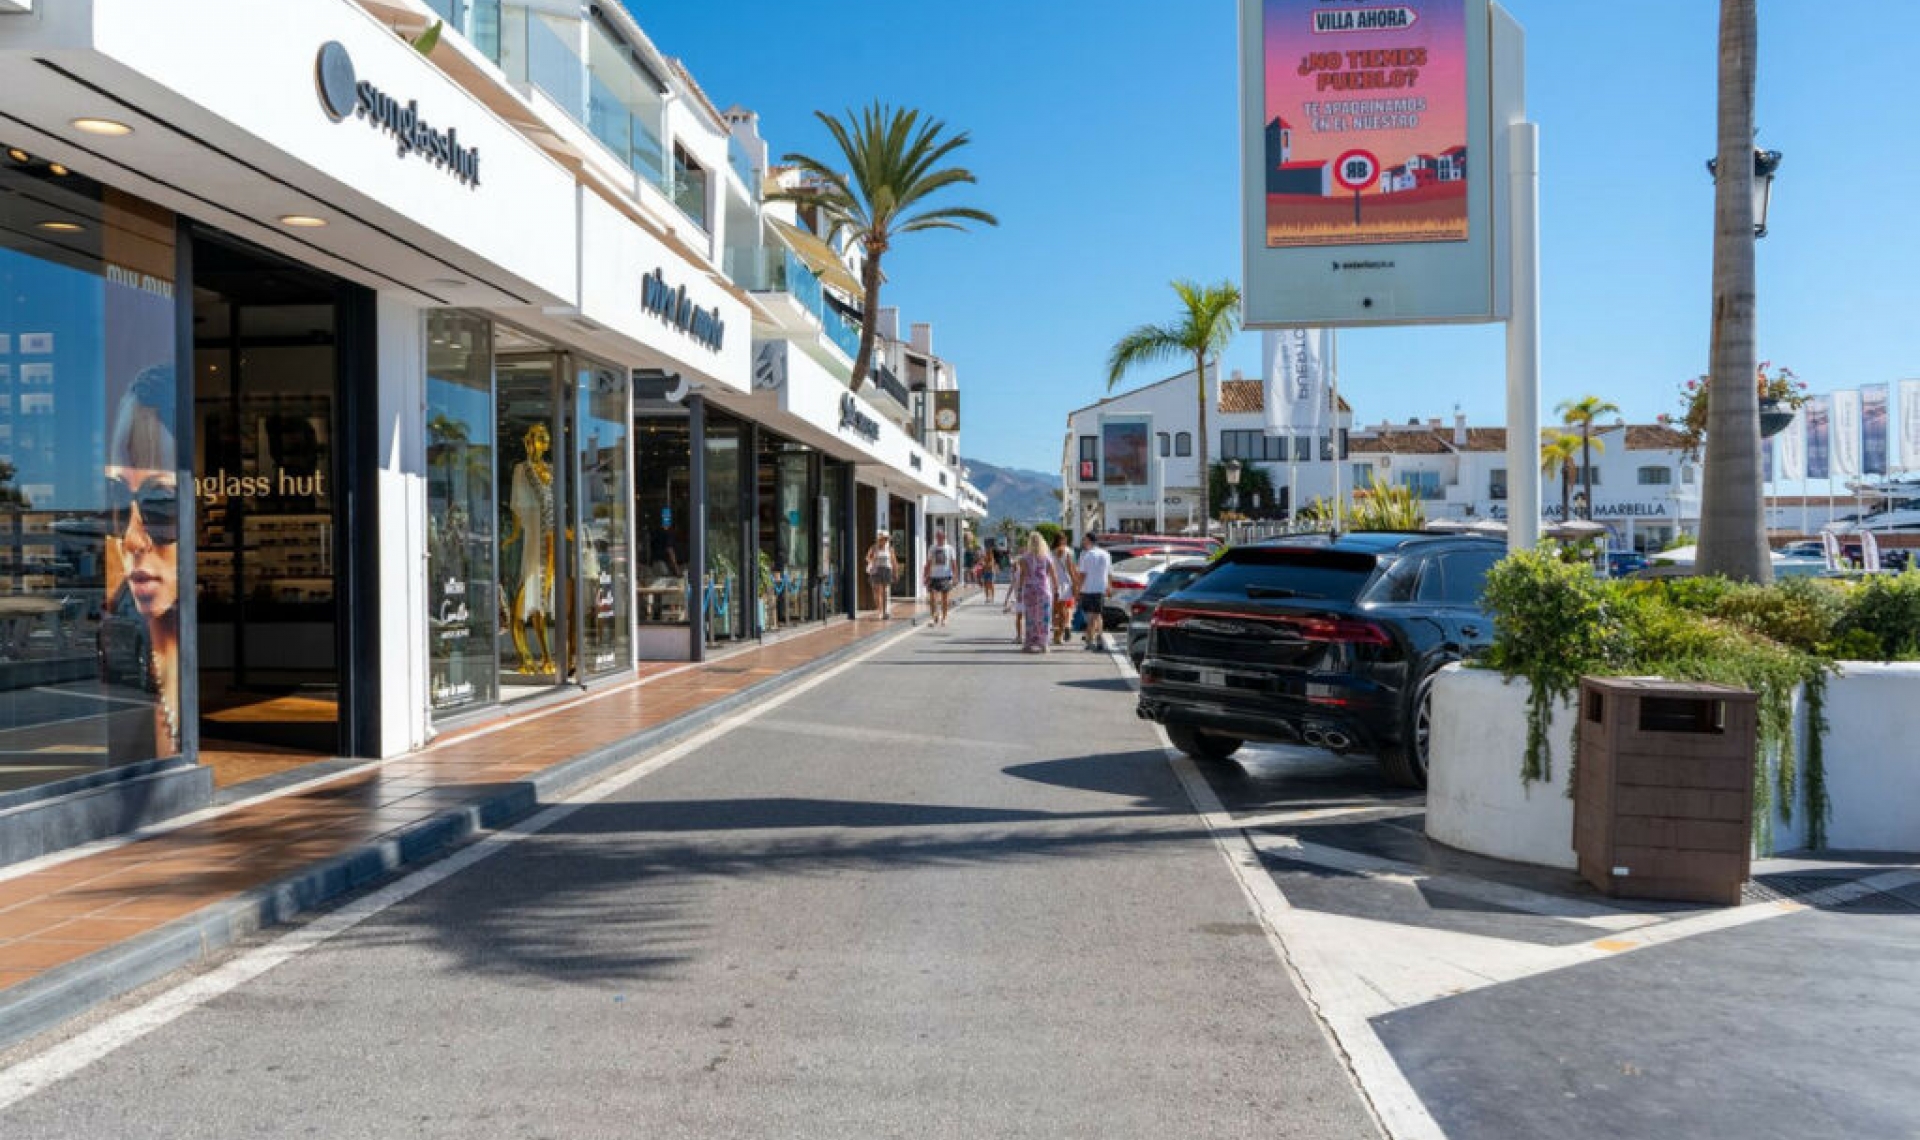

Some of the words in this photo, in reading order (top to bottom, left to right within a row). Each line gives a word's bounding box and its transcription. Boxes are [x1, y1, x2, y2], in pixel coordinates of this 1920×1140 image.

[1316, 12, 1354, 30] VILLA
[1357, 9, 1408, 28] AHORA
[1345, 48, 1428, 69] TIENES
[1316, 67, 1420, 91] PUEBLO?
[1304, 101, 1320, 117] TE
[1324, 97, 1428, 115] APADRINAMOS
[1311, 117, 1330, 133] EN
[1333, 115, 1349, 132] EL
[1352, 114, 1420, 131] NUESTRO
[278, 465, 325, 497] hut
[1593, 502, 1667, 516] MARBELLA
